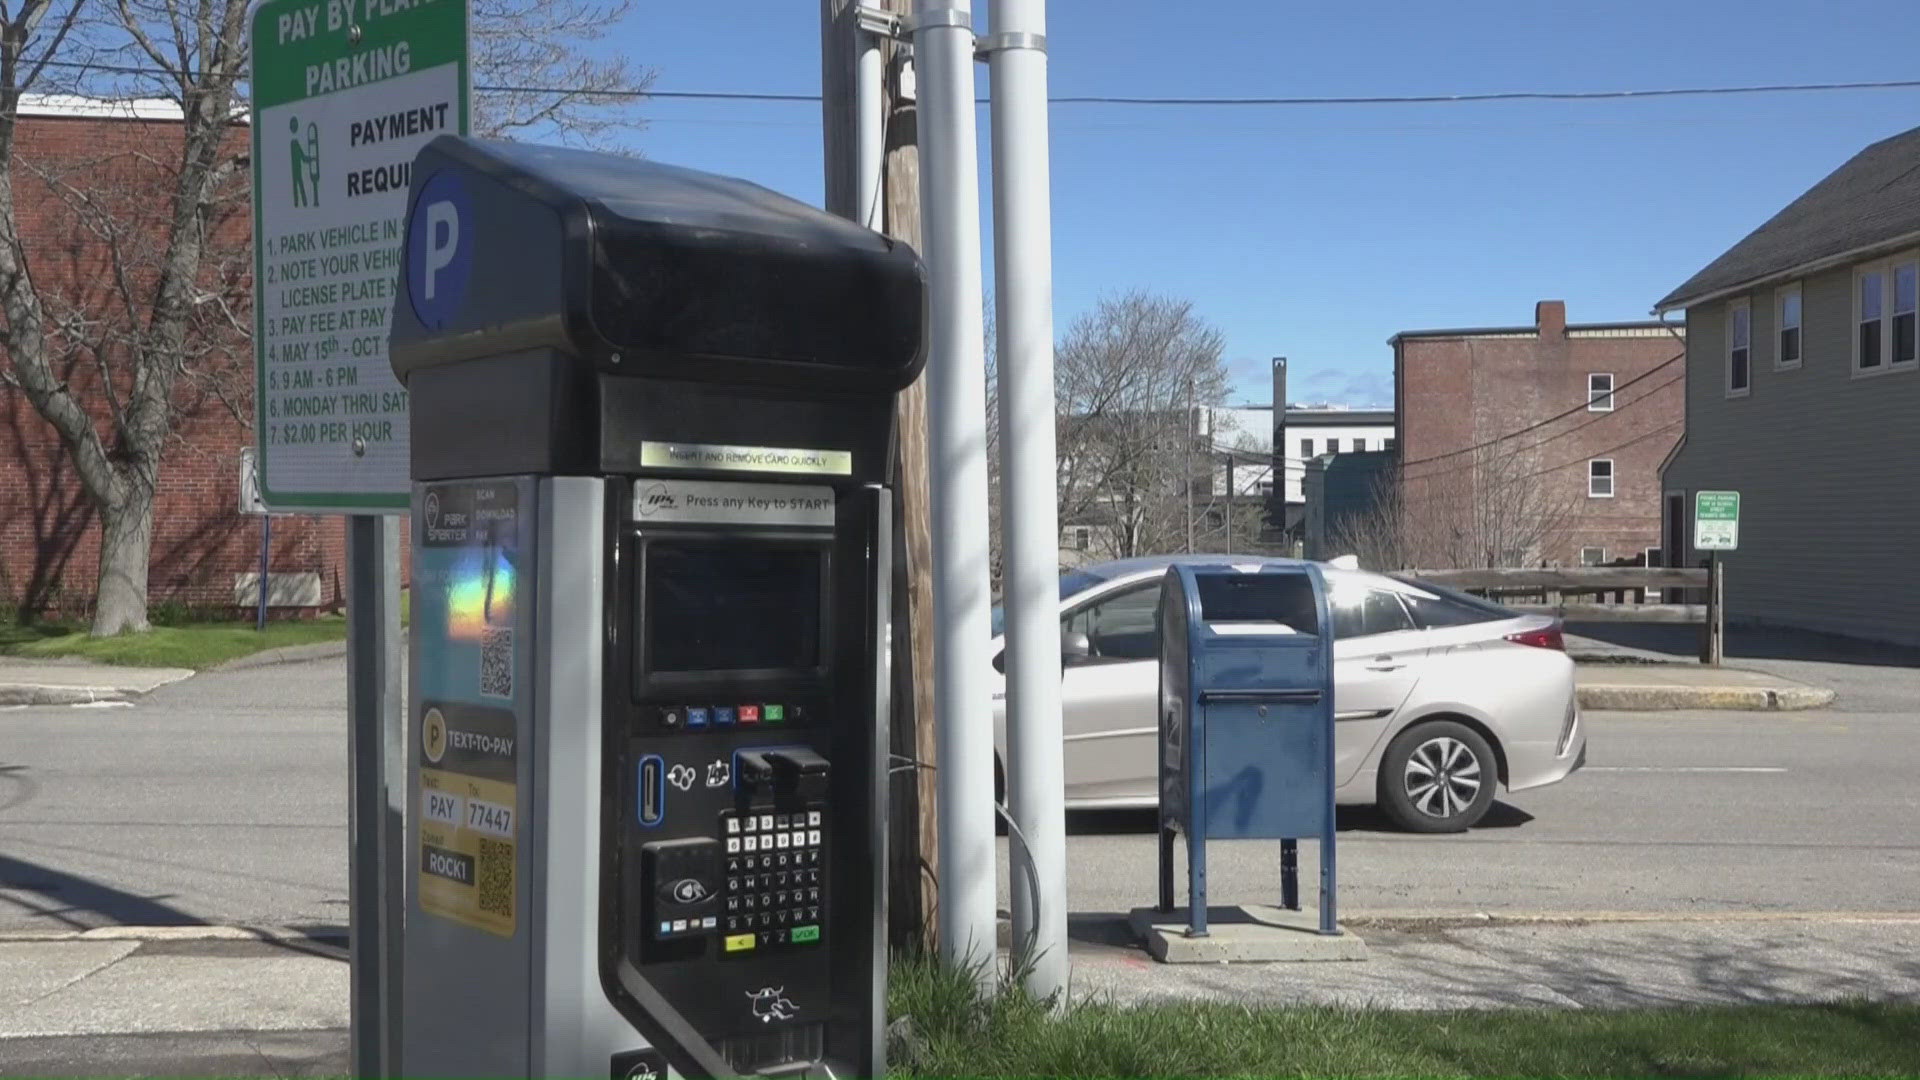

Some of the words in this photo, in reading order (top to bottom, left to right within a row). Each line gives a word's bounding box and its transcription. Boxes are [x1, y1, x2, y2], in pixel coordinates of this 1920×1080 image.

[278, 5, 319, 45] PAY
[328, 0, 358, 32] BY
[306, 40, 411, 97] PARKING
[350, 102, 449, 147] PAYMENT
[347, 161, 415, 197] REQUI
[267, 238, 277, 256] 1.
[280, 233, 316, 254] PARK
[320, 221, 379, 250] VEHICLE
[383, 218, 397, 240] IN
[425, 200, 459, 300] P
[268, 266, 278, 284] 2.
[280, 258, 316, 281] NOTE
[320, 252, 360, 276] YOUR
[281, 284, 337, 308] LICENSE
[342, 278, 386, 301] PLATE
[268, 319, 279, 336] 3.
[282, 315, 306, 336] PAY
[310, 311, 337, 330] FEE
[339, 310, 356, 330] AT
[360, 306, 386, 328] PAY
[282, 340, 311, 362] MAY
[351, 335, 381, 357] OCT
[282, 371, 290, 389] 9
[292, 370, 313, 388] AM
[325, 368, 334, 387] 6
[338, 367, 358, 386] PM
[283, 395, 337, 417] MONDAY
[342, 393, 378, 414] THRU
[382, 391, 408, 412] SAT
[283, 424, 316, 445] $2.00
[320, 423, 348, 443] PER
[352, 420, 393, 442] HOUR
[705, 451, 723, 462] AND
[726, 452, 763, 465] REMOVE
[765, 453, 789, 465] CARD
[791, 455, 828, 468] QUICKLY
[686, 494, 719, 508] Press
[722, 498, 745, 511] any
[748, 496, 771, 511] Key
[774, 498, 786, 510] to
[790, 499, 831, 511] START
[430, 724, 440, 749] P
[447, 730, 514, 757] TEXT-TO-PAY
[430, 794, 455, 820] PAY
[469, 803, 511, 833] 77447
[430, 853, 466, 880] ROCK1
